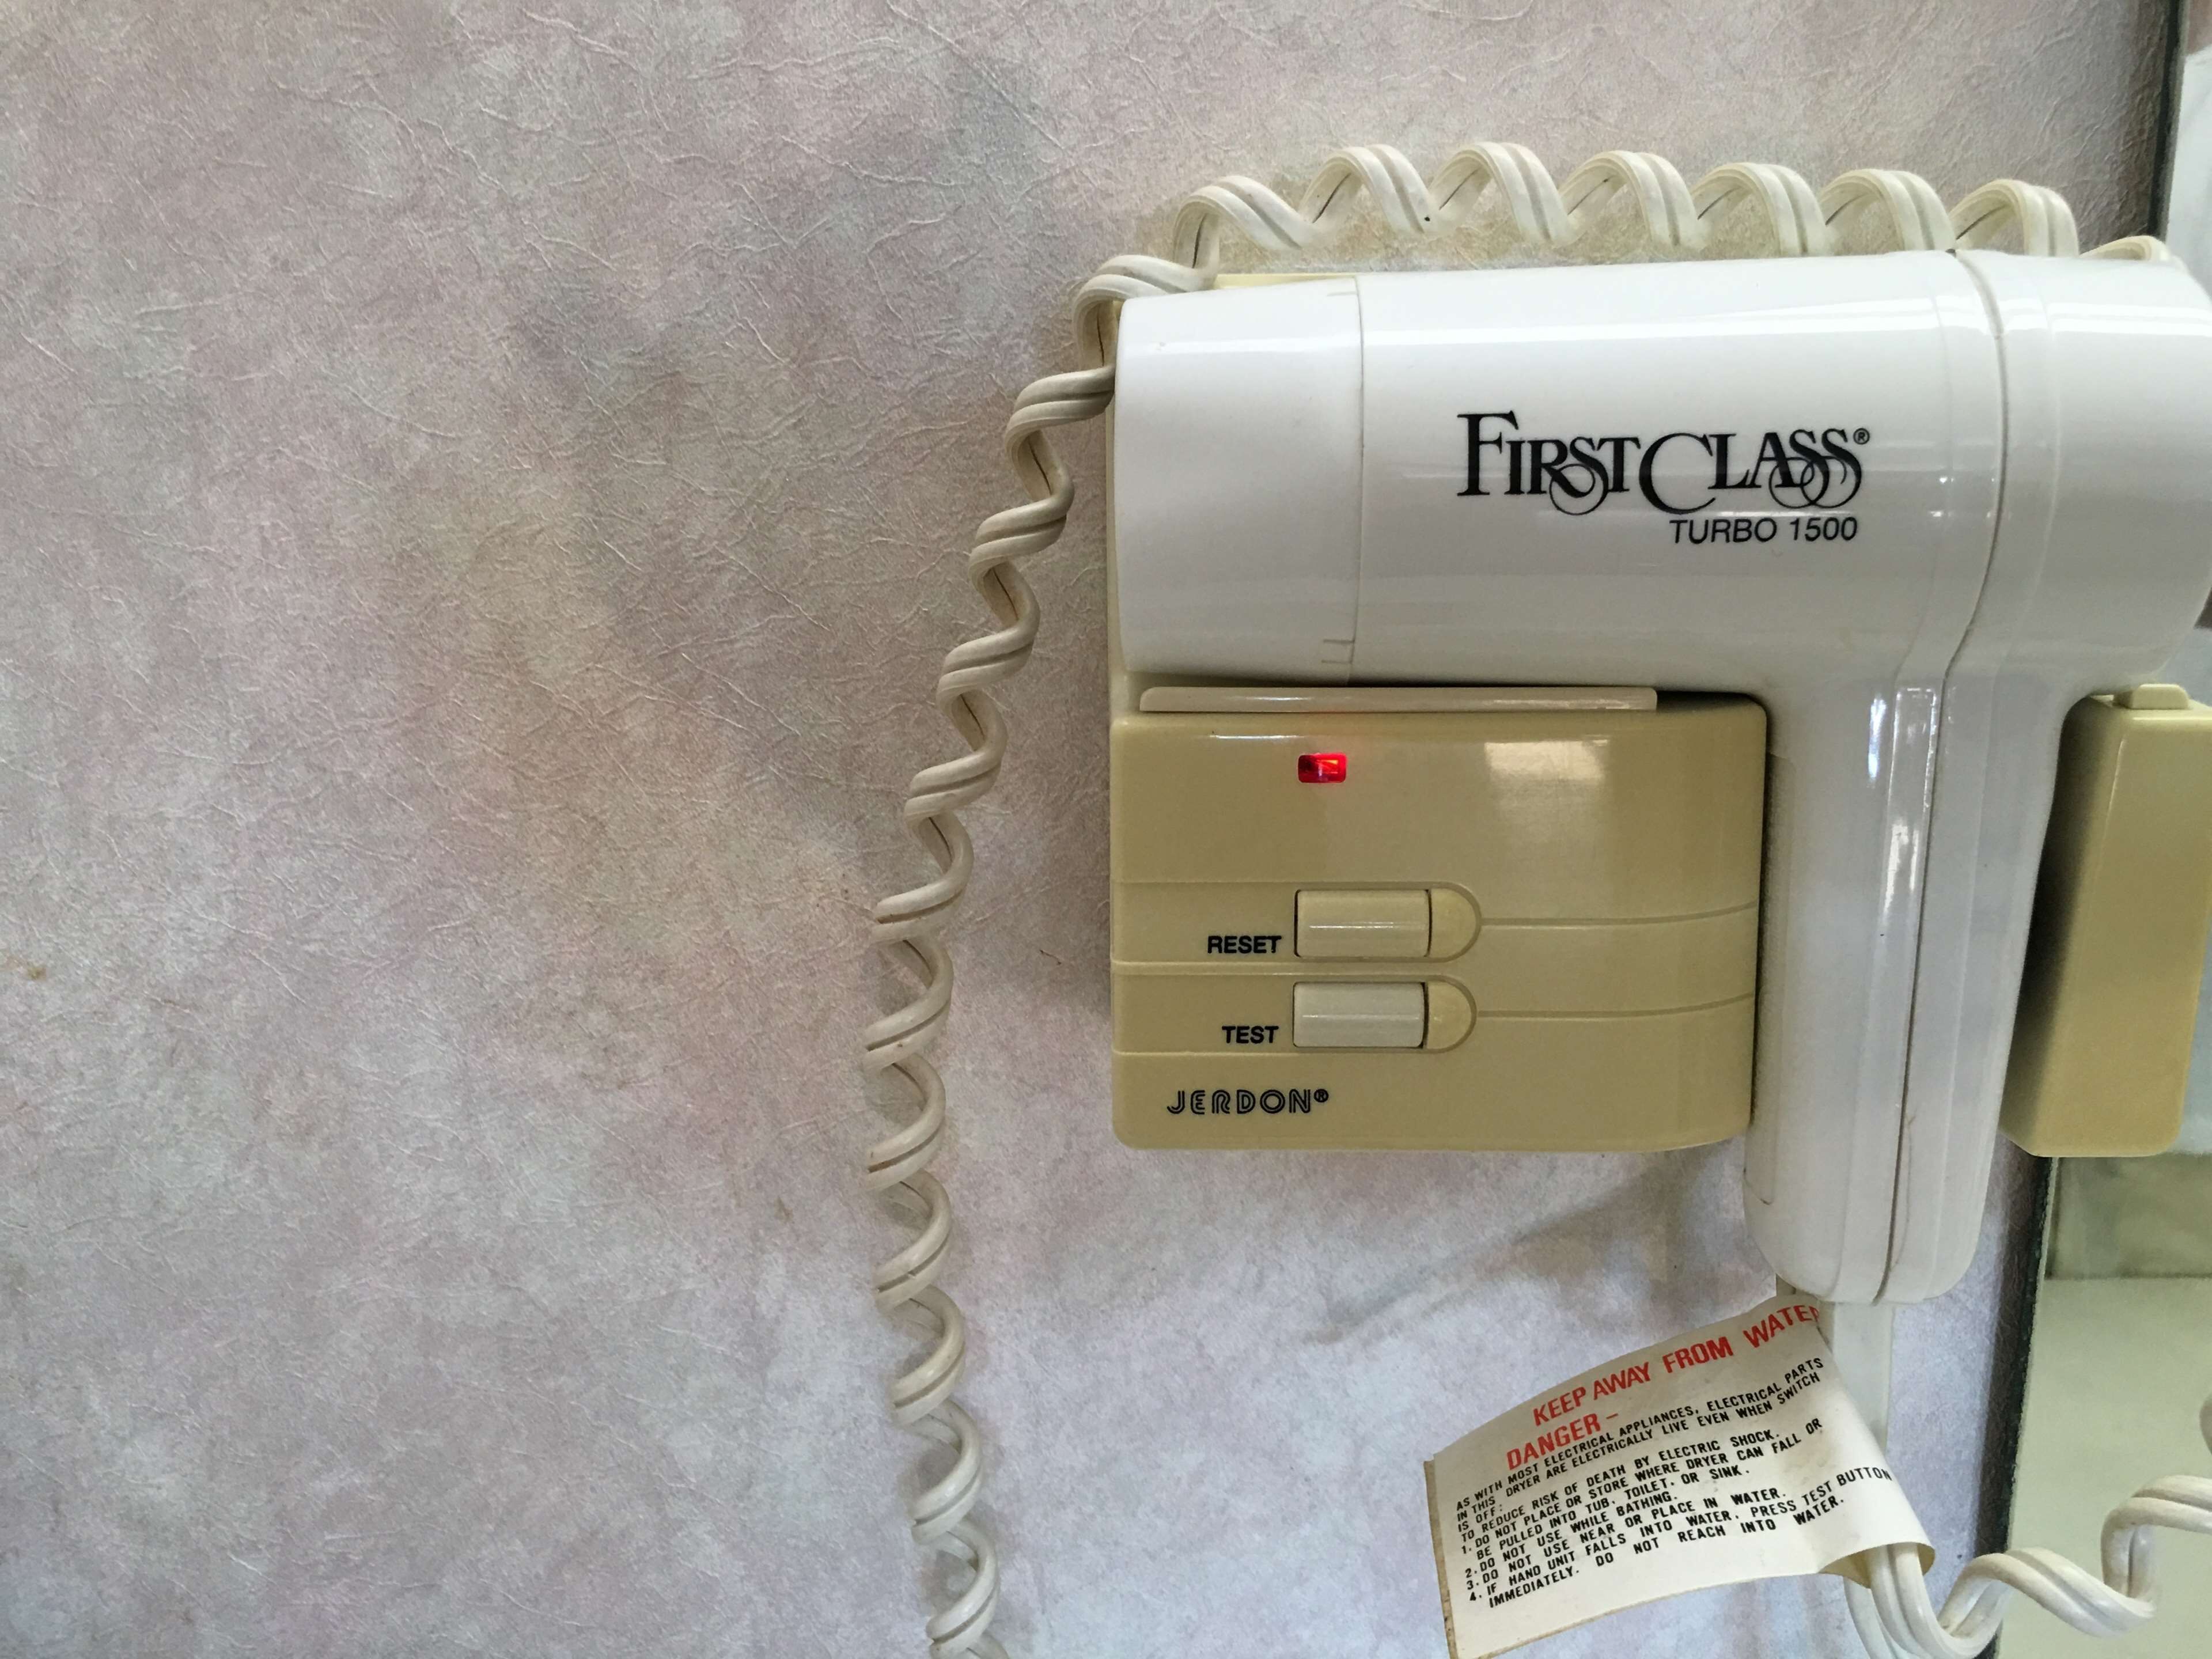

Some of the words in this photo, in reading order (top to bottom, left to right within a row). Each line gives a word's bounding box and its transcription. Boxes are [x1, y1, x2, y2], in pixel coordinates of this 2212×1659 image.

[1669, 518, 1777, 544] TURBO
[1790, 517, 1858, 541] 1500
[1207, 935, 1282, 953] RESET
[1222, 1025, 1279, 1044] TEST
[1533, 1387, 1586, 1427] KEEP
[1593, 1362, 1651, 1400] AWAY
[1662, 1336, 1733, 1373] FROM
[1456, 1497, 1470, 1511] AS
[1475, 1480, 1502, 1499] WITH
[1508, 1463, 1538, 1484] MOST
[1544, 1433, 1613, 1467] ELECTRICAL
[1619, 1406, 1699, 1436] APPLIANCES,
[1707, 1383, 1781, 1411] ELECTRICAL
[1785, 1358, 1824, 1383] PARTS
[1457, 1510, 1468, 1521] IN
[1472, 1496, 1496, 1514] THIS
[1506, 1474, 1540, 1497] DRYER
[1546, 1463, 1567, 1479] ARE
[1571, 1429, 1653, 1468] ELECTRICALLY
[1661, 1420, 1689, 1434] LIVE
[1697, 1412, 1729, 1427] EVEN
[1736, 1400, 1772, 1418] WHEN
[1777, 1372, 1820, 1404] SWITCH
[1506, 1413, 1600, 1470] DANGER
[1458, 1521, 1469, 1532] IS
[1461, 1530, 1475, 1542] TO
[1482, 1505, 1525, 1533] REDUCE
[1532, 1491, 1559, 1510] RISK
[1565, 1482, 1578, 1496] OF
[1586, 1465, 1626, 1487] DEATH
[1634, 1456, 1650, 1469] BY
[1658, 1440, 1721, 1461] ELECTRIC
[1730, 1429, 1779, 1447] SHOCK.
[1475, 1535, 1490, 1548] DO
[1495, 1521, 1517, 1538] NOT
[1524, 1503, 1561, 1525] PLACE
[1566, 1495, 1582, 1508] OR
[1589, 1477, 1628, 1498] STORE
[1634, 1462, 1679, 1482] WHERE
[1686, 1453, 1728, 1469] DRYER
[1737, 1446, 1764, 1461] CAN
[1771, 1433, 1802, 1454] FALL
[1805, 1418, 1822, 1435] OR
[1477, 1546, 1492, 1560] BE
[1499, 1524, 1543, 1550] PULLED
[1549, 1510, 1577, 1528] INTO
[1681, 1472, 1699, 1484] OR
[1709, 1465, 1749, 1479] SINK.
[1479, 1558, 1495, 1572] DO
[1502, 1543, 1525, 1562] NOT
[1537, 1529, 1562, 1547] USE
[1570, 1512, 1609, 1533] WHILE
[1616, 1491, 1677, 1517] BATHING.
[1483, 1569, 1498, 1584] DO
[1508, 1555, 1532, 1573] NOT
[1543, 1539, 1570, 1557] USE
[1580, 1523, 1615, 1544] NEAR
[1624, 1514, 1642, 1528] OR
[1651, 1501, 1695, 1520] PLACE
[1703, 1497, 1718, 1509] IN
[1730, 1487, 1786, 1505] WATER.
[1487, 1582, 1497, 1595] IF
[1509, 1565, 1541, 1586] HAND
[1548, 1551, 1575, 1570] UNIT
[1585, 1533, 1626, 1556] FALLS
[1639, 1520, 1672, 1537] INTO
[1750, 1501, 1797, 1517] PRESS
[1801, 1480, 1832, 1506] TEST
[1836, 1467, 1893, 1486] BUTTON
[1488, 1566, 1579, 1608] IMMEDIATELY.
[1596, 1552, 1613, 1566] DO
[1633, 1537, 1660, 1554] NOT
[1677, 1525, 1726, 1543] REACH
[1740, 1518, 1777, 1533] INTO
[1793, 1495, 1844, 1525] WATER.
